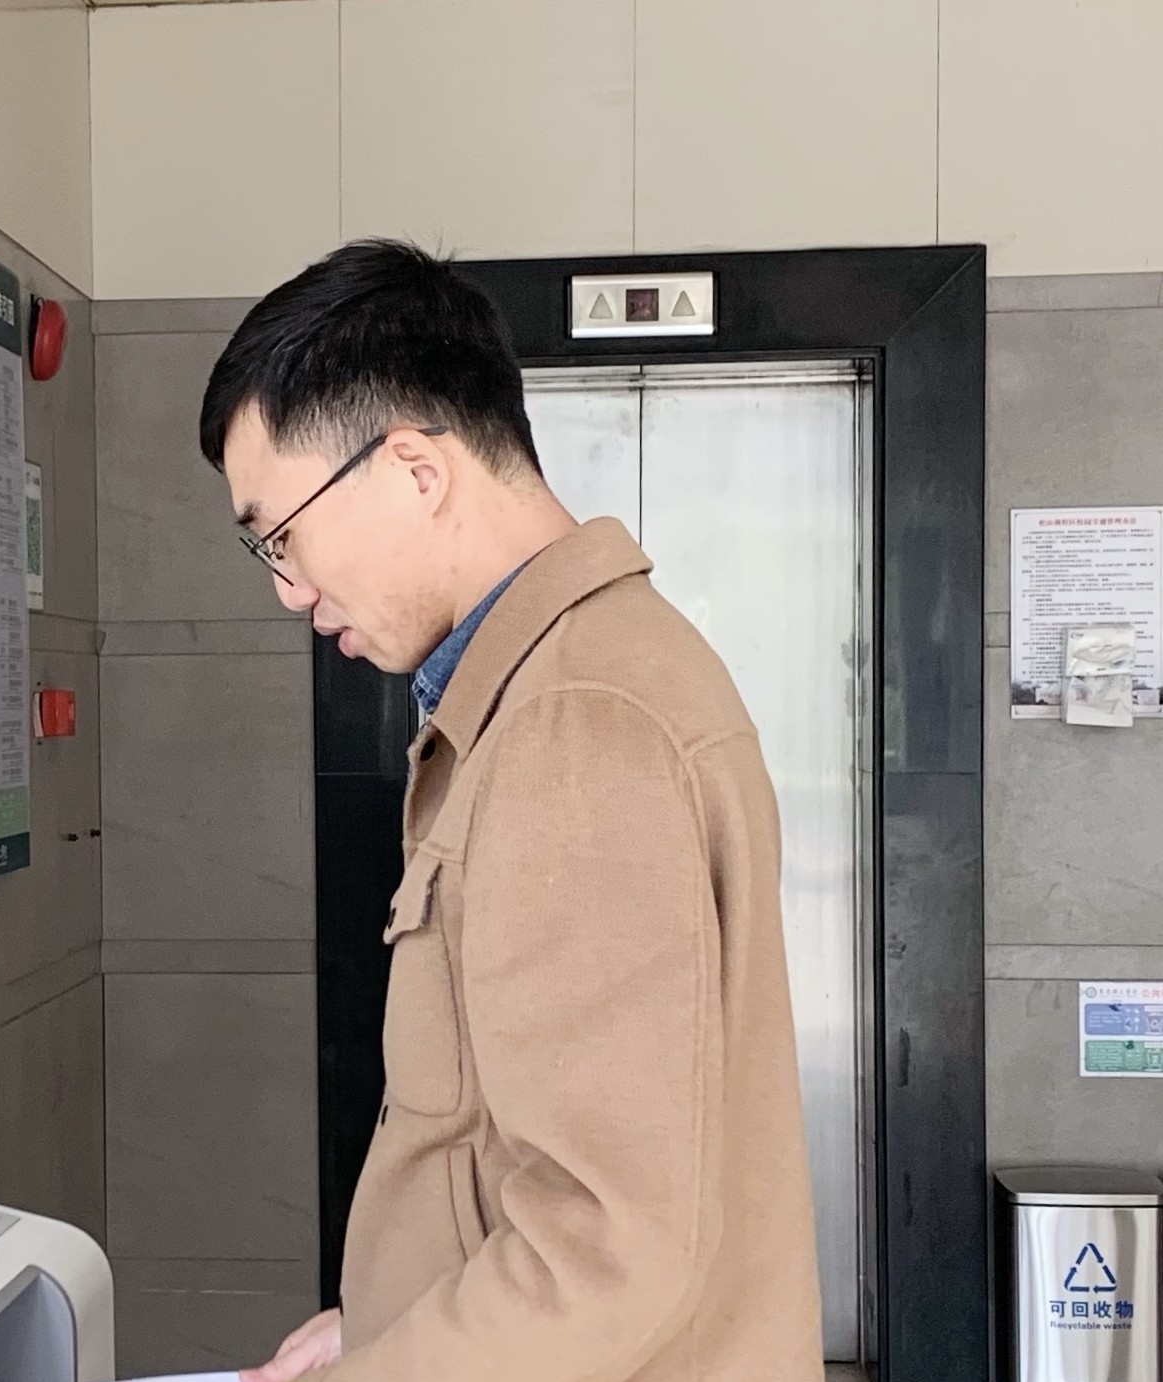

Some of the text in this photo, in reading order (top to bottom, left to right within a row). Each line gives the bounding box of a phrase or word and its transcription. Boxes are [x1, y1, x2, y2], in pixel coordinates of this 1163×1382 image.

[1049, 1300, 1134, 1318] 可回收物
[1050, 1321, 1101, 1330] Recyclable
